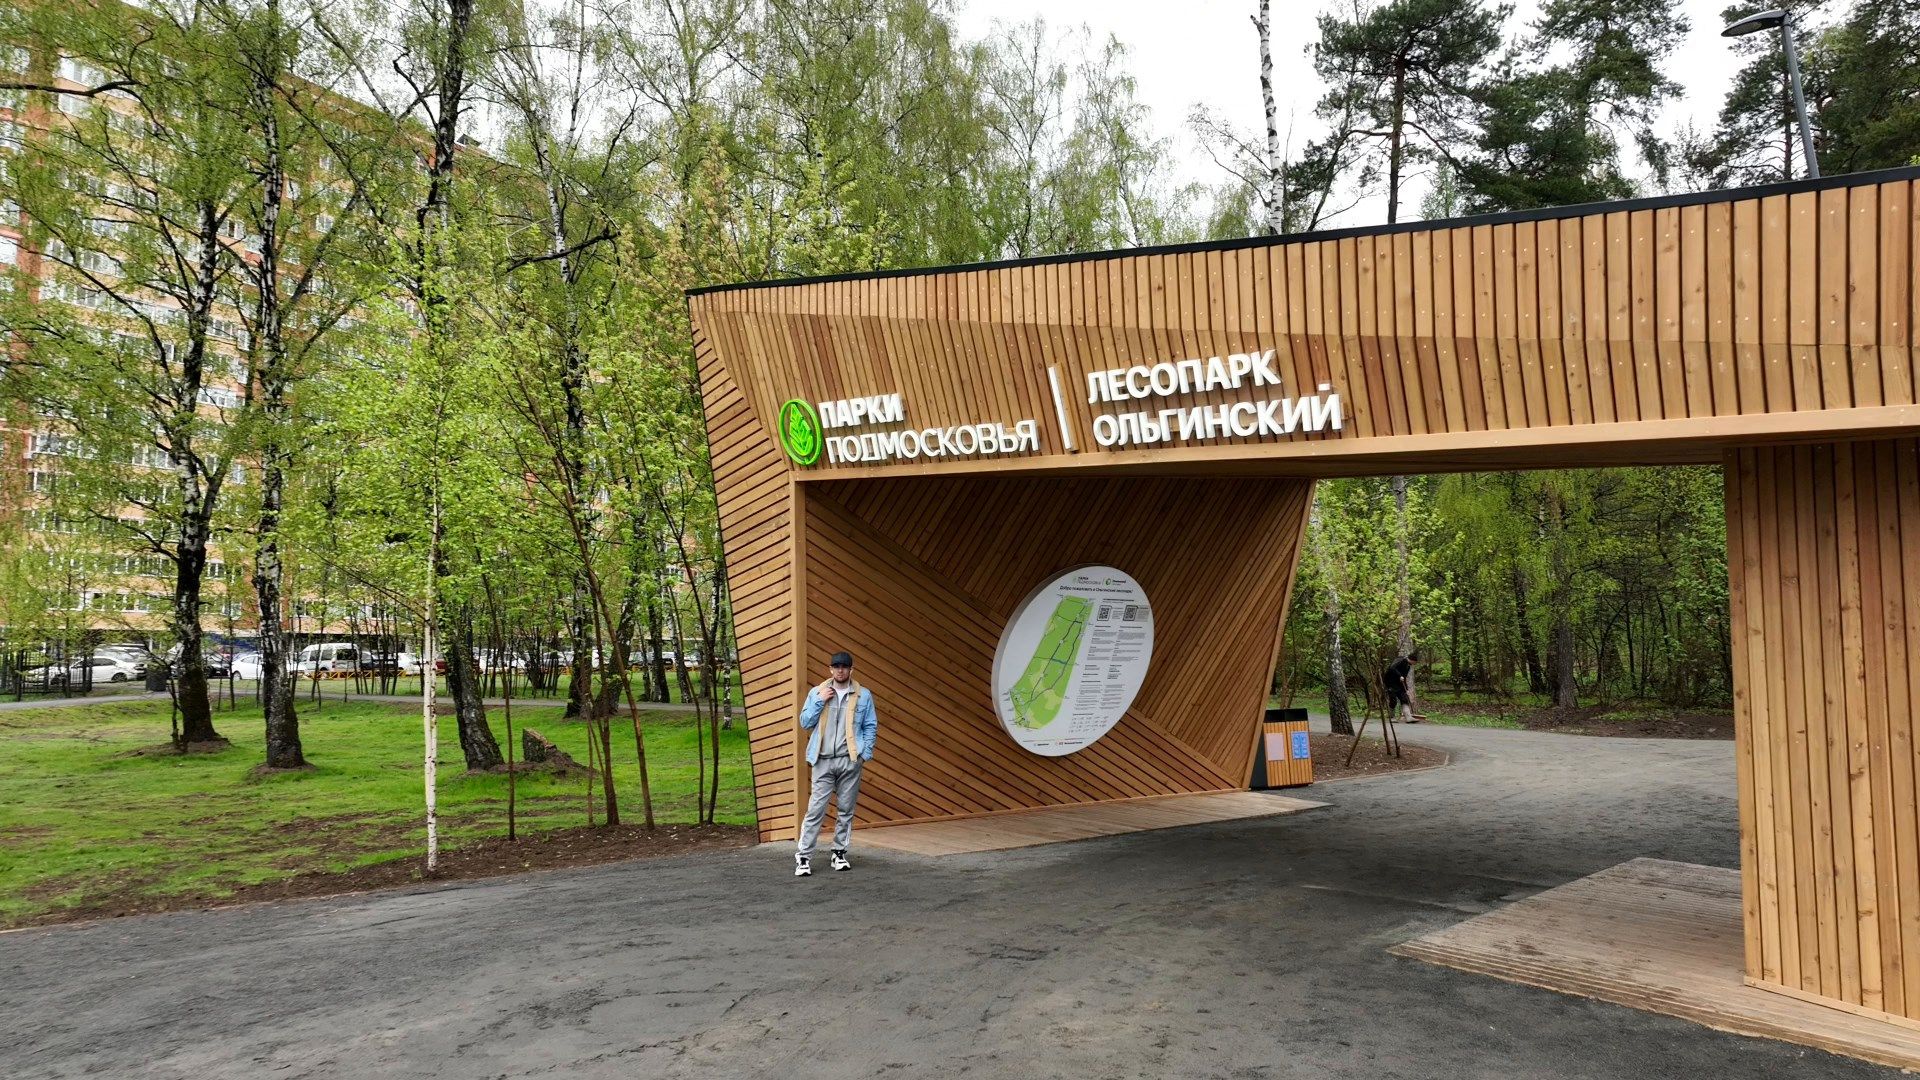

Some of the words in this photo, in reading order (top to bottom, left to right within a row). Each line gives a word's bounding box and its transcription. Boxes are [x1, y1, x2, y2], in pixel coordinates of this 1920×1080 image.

[1088, 349, 1282, 404] ЛЕСОПАРК
[818, 393, 904, 428] ПАРКИ
[1093, 383, 1343, 447] ОЛЬГИНСКИЙ
[825, 419, 1040, 464] ПОДМОСКОВЬЯ
